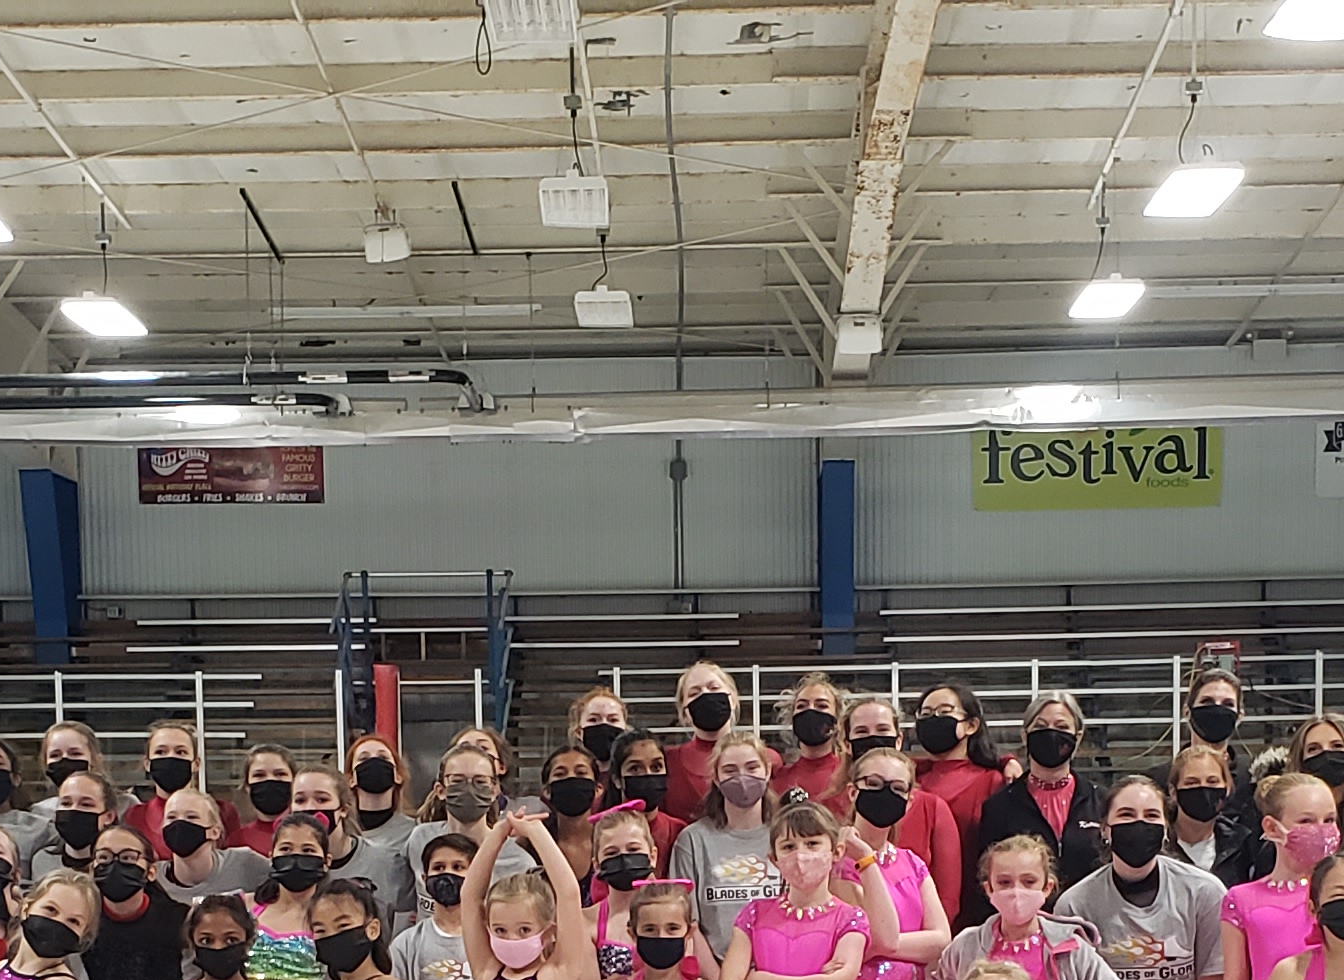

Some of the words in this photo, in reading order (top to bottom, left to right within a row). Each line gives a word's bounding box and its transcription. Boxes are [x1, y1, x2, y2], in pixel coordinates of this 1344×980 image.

[281, 453, 316, 463] FAMOUS
[980, 426, 1210, 484] festival
[285, 463, 313, 472] GRITTY
[283, 473, 315, 482] BURGER
[1145, 476, 1189, 488] foods
[157, 493, 190, 502] BURGERS
[202, 493, 223, 502] FRIES
[706, 887, 748, 901] BLADES
[1116, 970, 1141, 980] DES
[1159, 962, 1194, 979] GLOR
